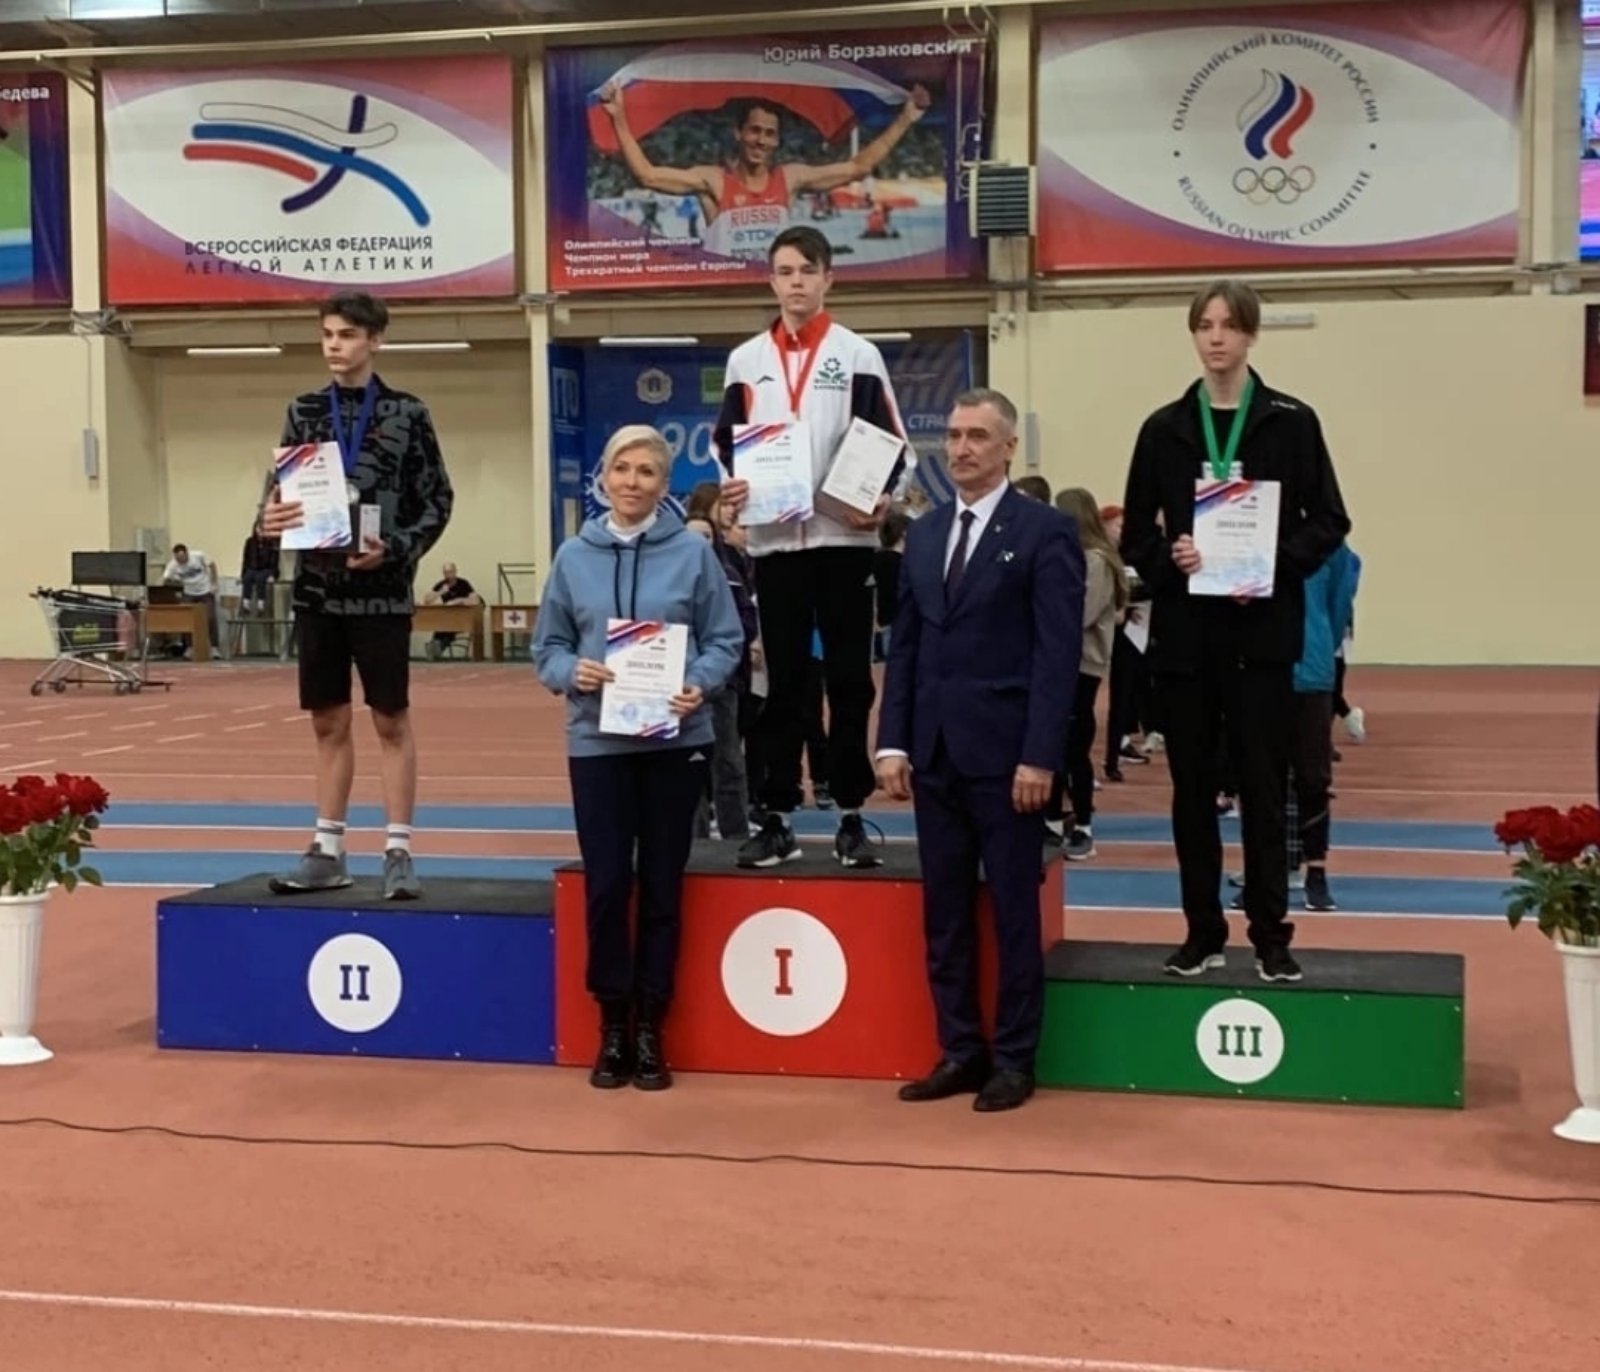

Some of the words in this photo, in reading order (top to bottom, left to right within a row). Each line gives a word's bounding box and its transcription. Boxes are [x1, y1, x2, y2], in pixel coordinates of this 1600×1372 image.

[764, 44, 822, 65] Юрий
[828, 40, 972, 61] Борзаковский
[0, 86, 50, 101] едева
[1172, 33, 1267, 131] ОЛИМПИЙСКИЙ
[1271, 33, 1343, 65] КОМИТЕТ
[1340, 60, 1380, 124] РОССИИ
[1178, 174, 1225, 229] RUSSIAN
[1227, 221, 1298, 242] OLYMPIC
[1299, 169, 1373, 237] COMMITTEE
[184, 235, 332, 256] ВСЕРОССИЙСКАЯ
[335, 235, 433, 253] ФЕДЕРАЦИЯ
[564, 236, 646, 250] Олимпийский
[185, 256, 282, 275] ЛЕГКОЙ
[303, 256, 433, 272] АТЛЕТИКИ
[700, 261, 747, 274] Европы
[339, 964, 370, 1001] II
[774, 948, 793, 995] I
[1217, 1025, 1263, 1057] III
